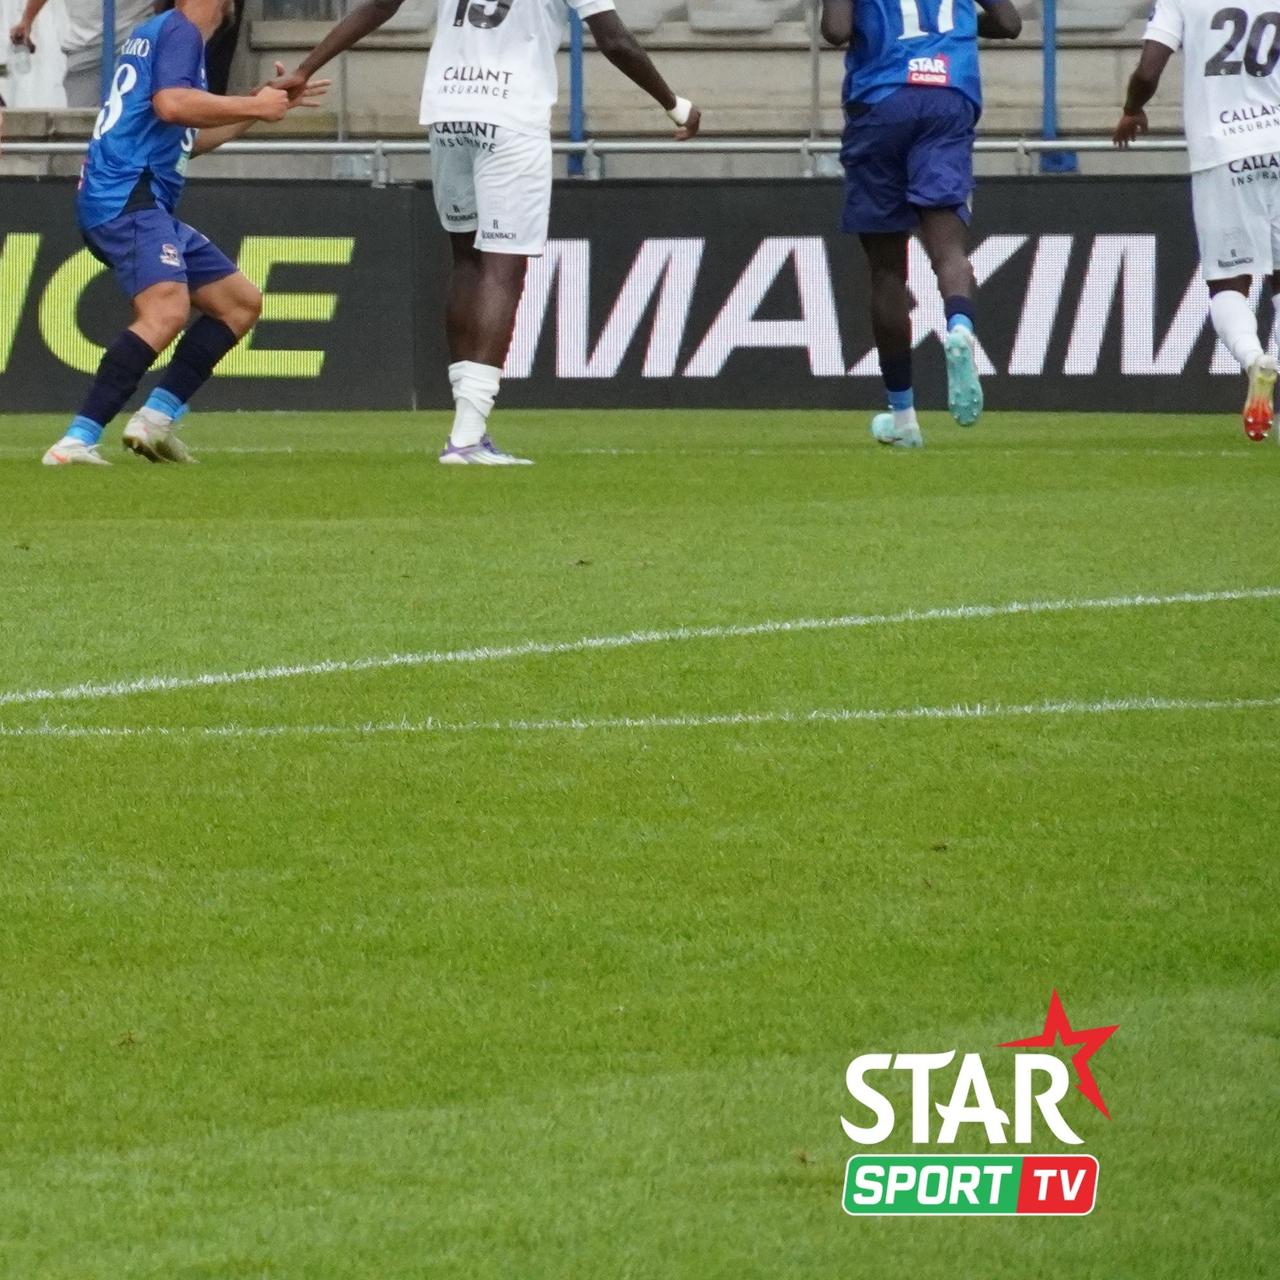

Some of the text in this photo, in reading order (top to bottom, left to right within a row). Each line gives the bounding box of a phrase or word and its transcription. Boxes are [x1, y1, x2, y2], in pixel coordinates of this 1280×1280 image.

[1204, 7, 1280, 77] 20
[908, 57, 947, 73] STAR
[444, 66, 512, 84] CALLANT
